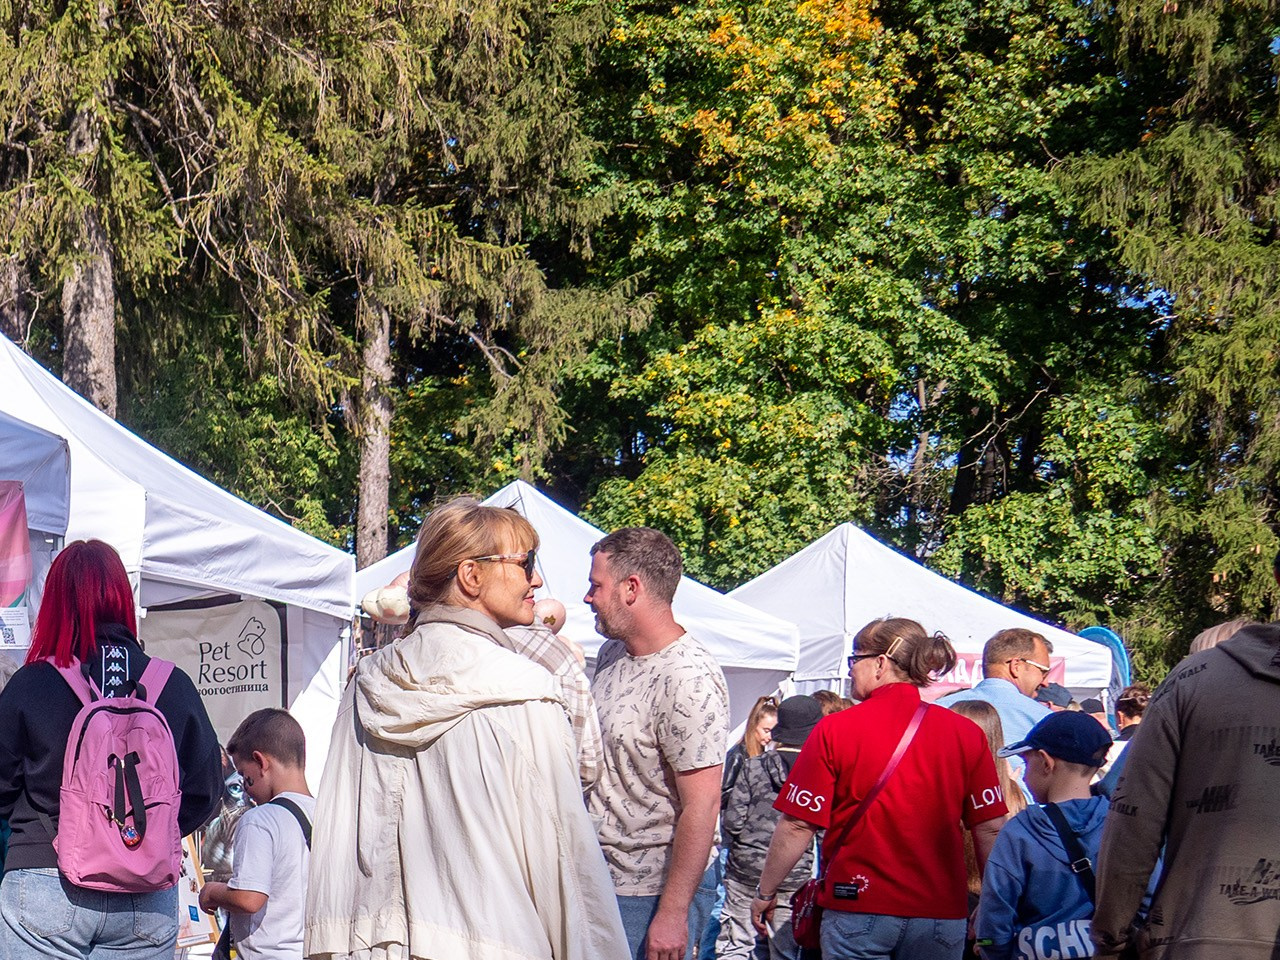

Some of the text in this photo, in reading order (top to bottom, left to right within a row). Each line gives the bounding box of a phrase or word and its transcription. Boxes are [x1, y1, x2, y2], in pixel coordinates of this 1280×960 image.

[199, 641, 231, 663] Pet
[198, 660, 268, 684] Resort
[787, 783, 826, 812] TAGS
